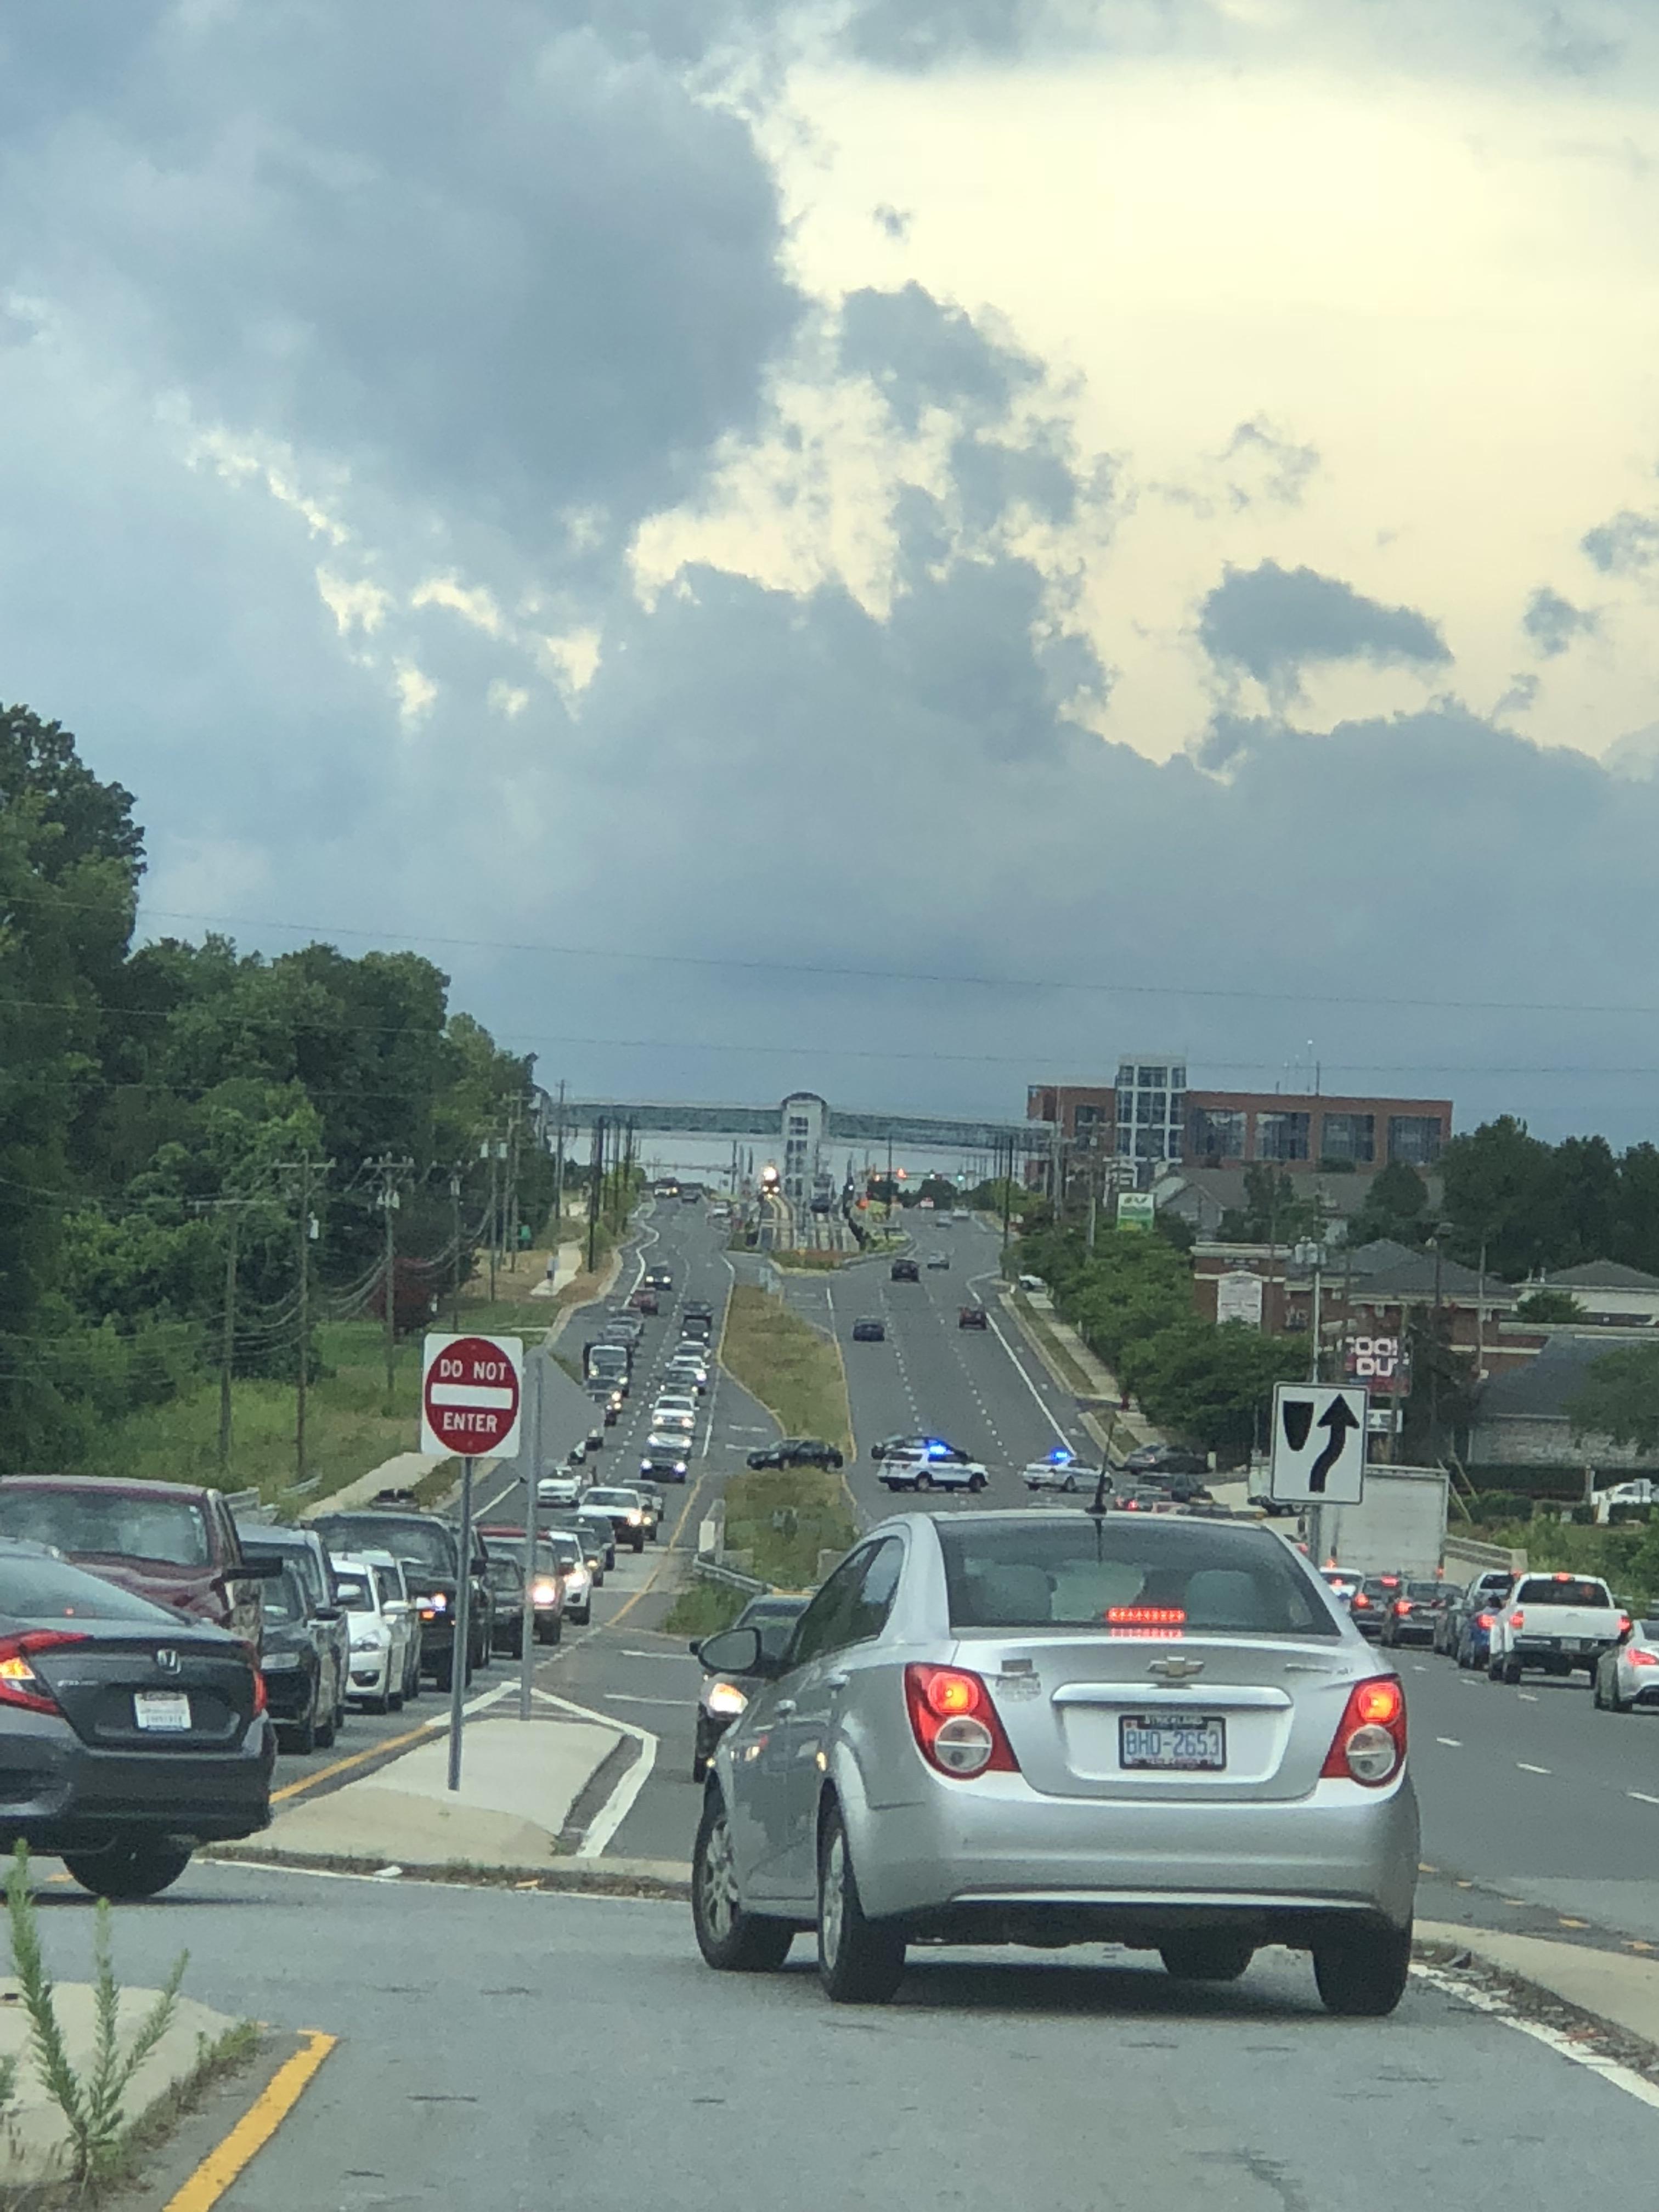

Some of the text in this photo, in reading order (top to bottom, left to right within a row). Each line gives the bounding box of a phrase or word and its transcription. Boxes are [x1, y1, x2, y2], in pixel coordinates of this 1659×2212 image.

[441, 1359, 507, 1380] DO NOT
[443, 1412, 498, 1433] ENTER
